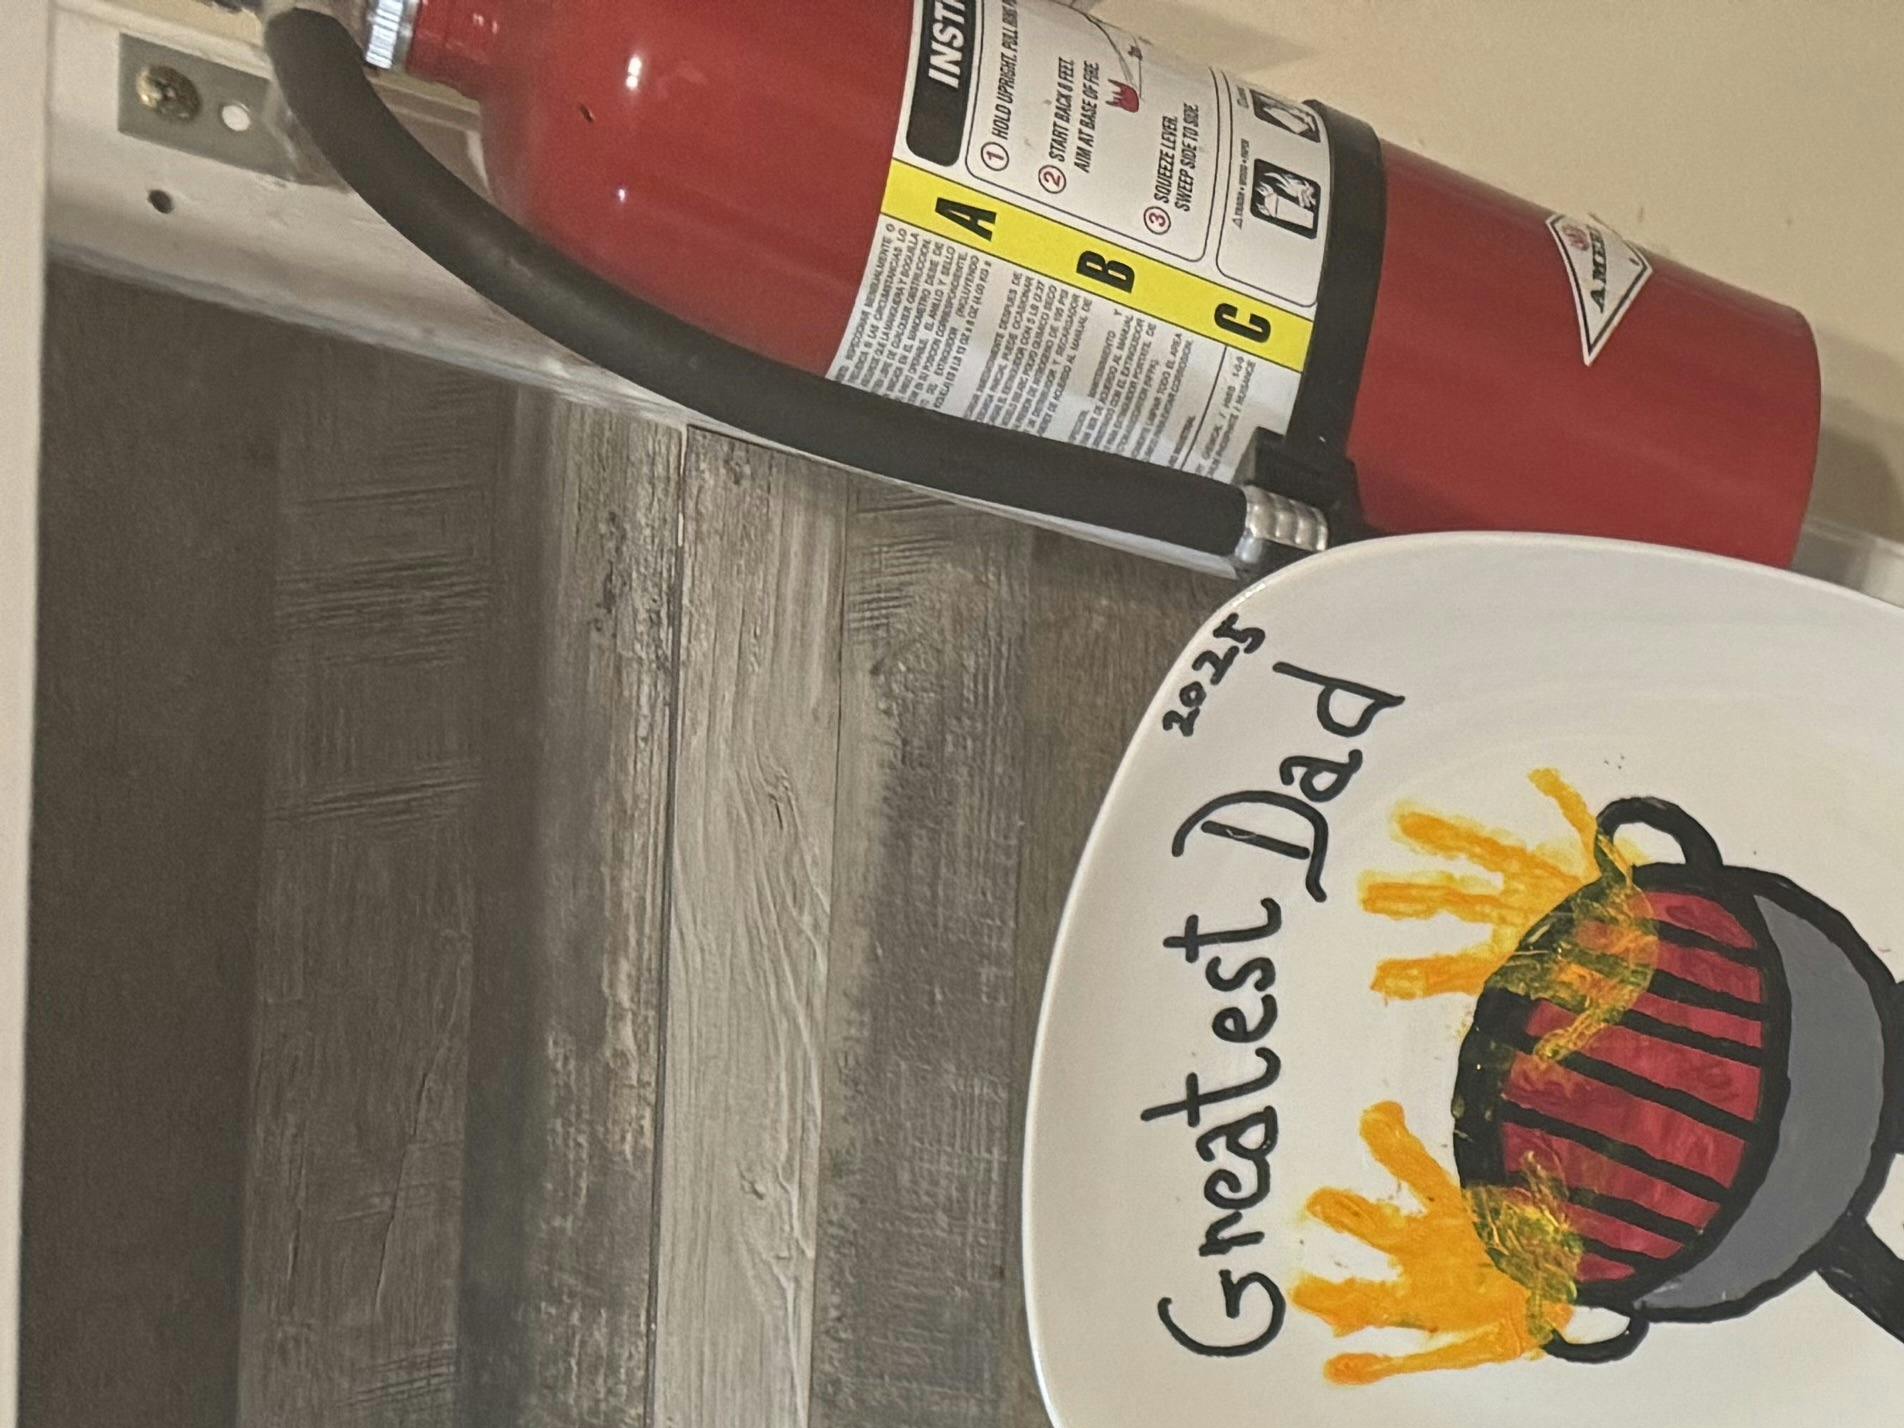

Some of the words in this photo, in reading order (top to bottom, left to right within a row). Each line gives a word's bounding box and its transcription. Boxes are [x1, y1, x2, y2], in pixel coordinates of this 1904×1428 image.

[990, 102, 1010, 140] HOLD
[1052, 88, 1071, 123] BACK
[1077, 97, 1095, 130] BASE
[1047, 121, 1068, 162] START
[1075, 127, 1093, 147] AT
[1180, 125, 1197, 141] TO
[1072, 144, 1091, 173] AIM
[1177, 140, 1195, 169] SIDE
[1152, 148, 1174, 204] SQUEEZE
[1173, 167, 1193, 212] SWEEP
[935, 197, 997, 242] A
[1076, 249, 1136, 295] B
[1213, 302, 1272, 343] C
[1163, 612, 1266, 737] 2025
[1172, 661, 1405, 902] Dad
[1141, 896, 1286, 1358] Greatest
